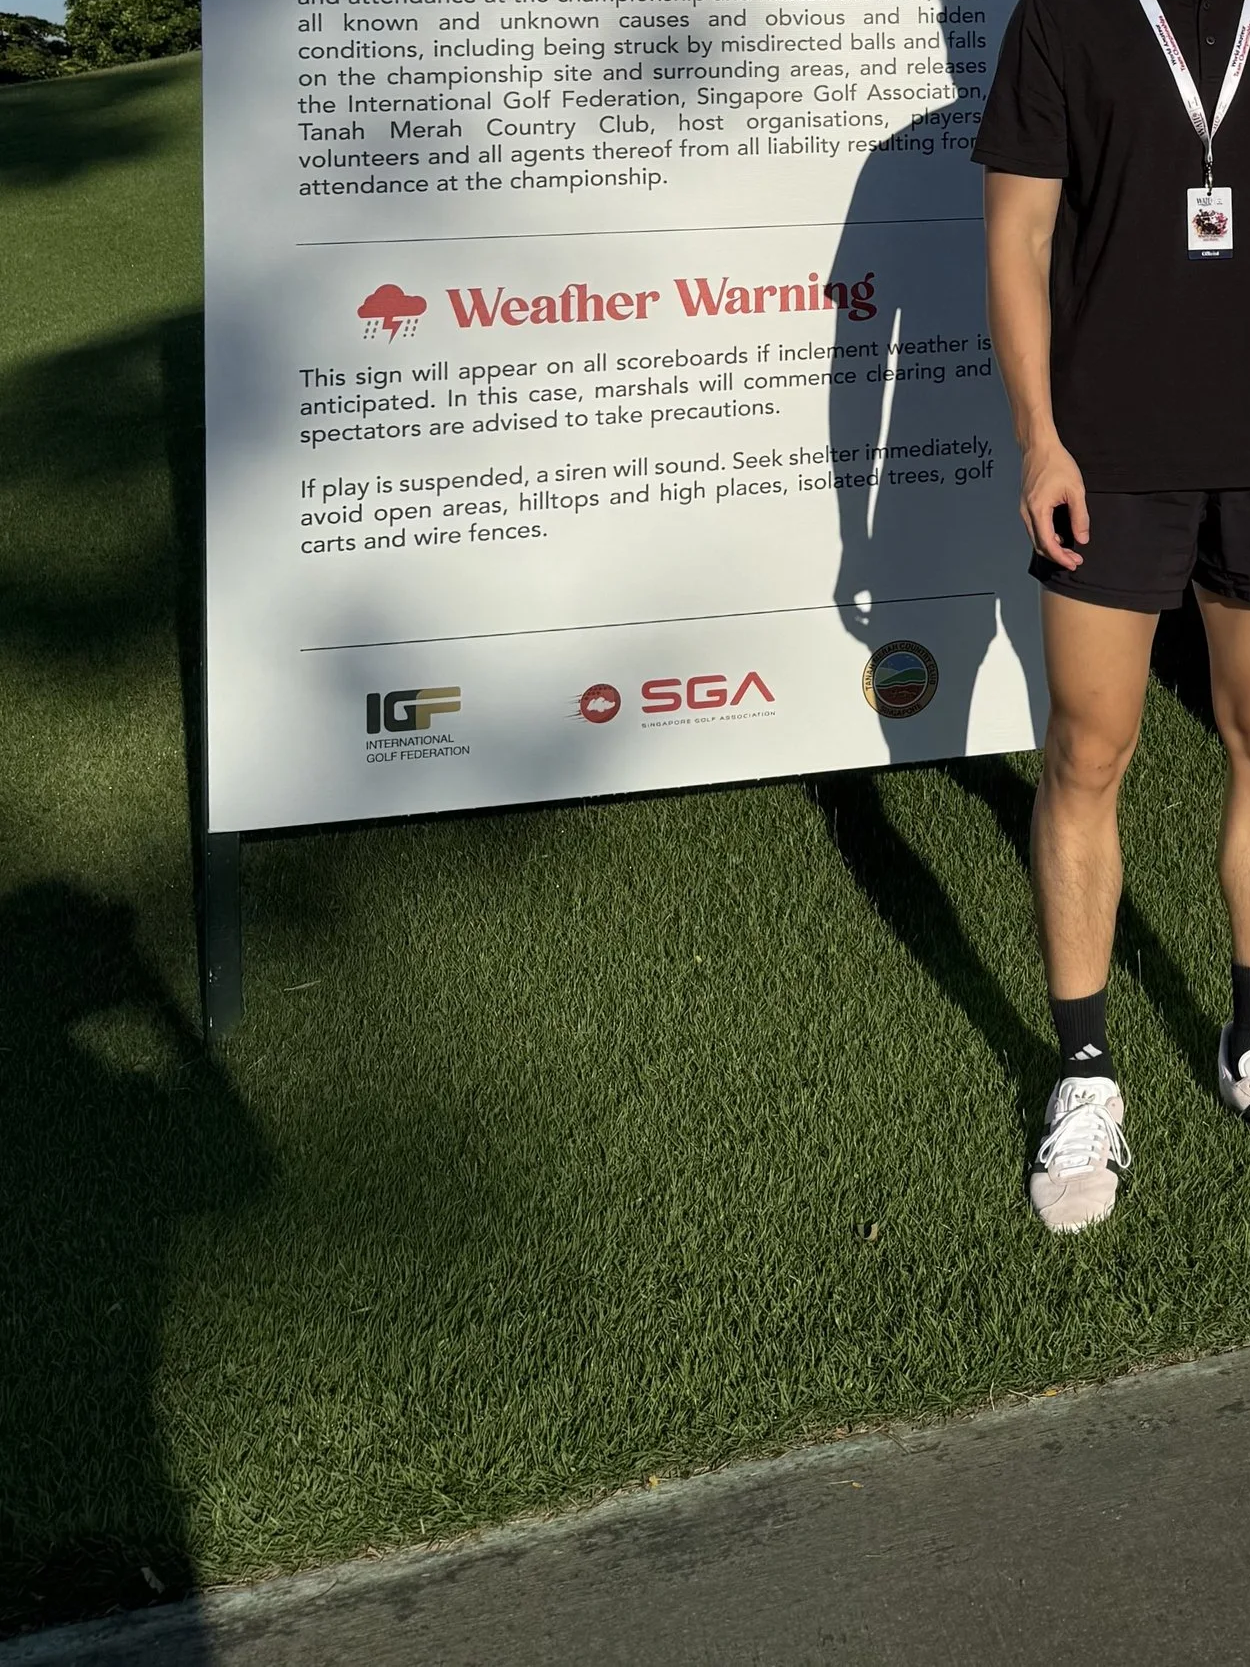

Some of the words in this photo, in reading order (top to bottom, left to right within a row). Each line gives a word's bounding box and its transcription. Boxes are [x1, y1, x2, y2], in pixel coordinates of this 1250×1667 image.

[300, 175, 428, 196] attendance
[437, 175, 458, 191] at
[465, 171, 502, 191] the
[510, 167, 667, 193] championship.
[446, 283, 660, 328] Weather
[674, 272, 877, 321] Warning
[300, 423, 421, 449] spectators
[429, 421, 464, 435] are
[472, 409, 557, 433] advised
[565, 412, 588, 427] to
[595, 405, 642, 425] take
[651, 399, 780, 428] precautions.
[301, 536, 356, 553] carts
[364, 528, 405, 549] and
[414, 527, 461, 545] wire
[468, 523, 547, 541] fences.
[367, 686, 461, 734] IGF
[641, 719, 690, 728] SINGAPORE
[720, 711, 775, 721] ASSOCIATION
[366, 734, 454, 750] INTERNATIONAL
[366, 751, 398, 763] GOLF
[400, 746, 470, 760] FEDERATION
